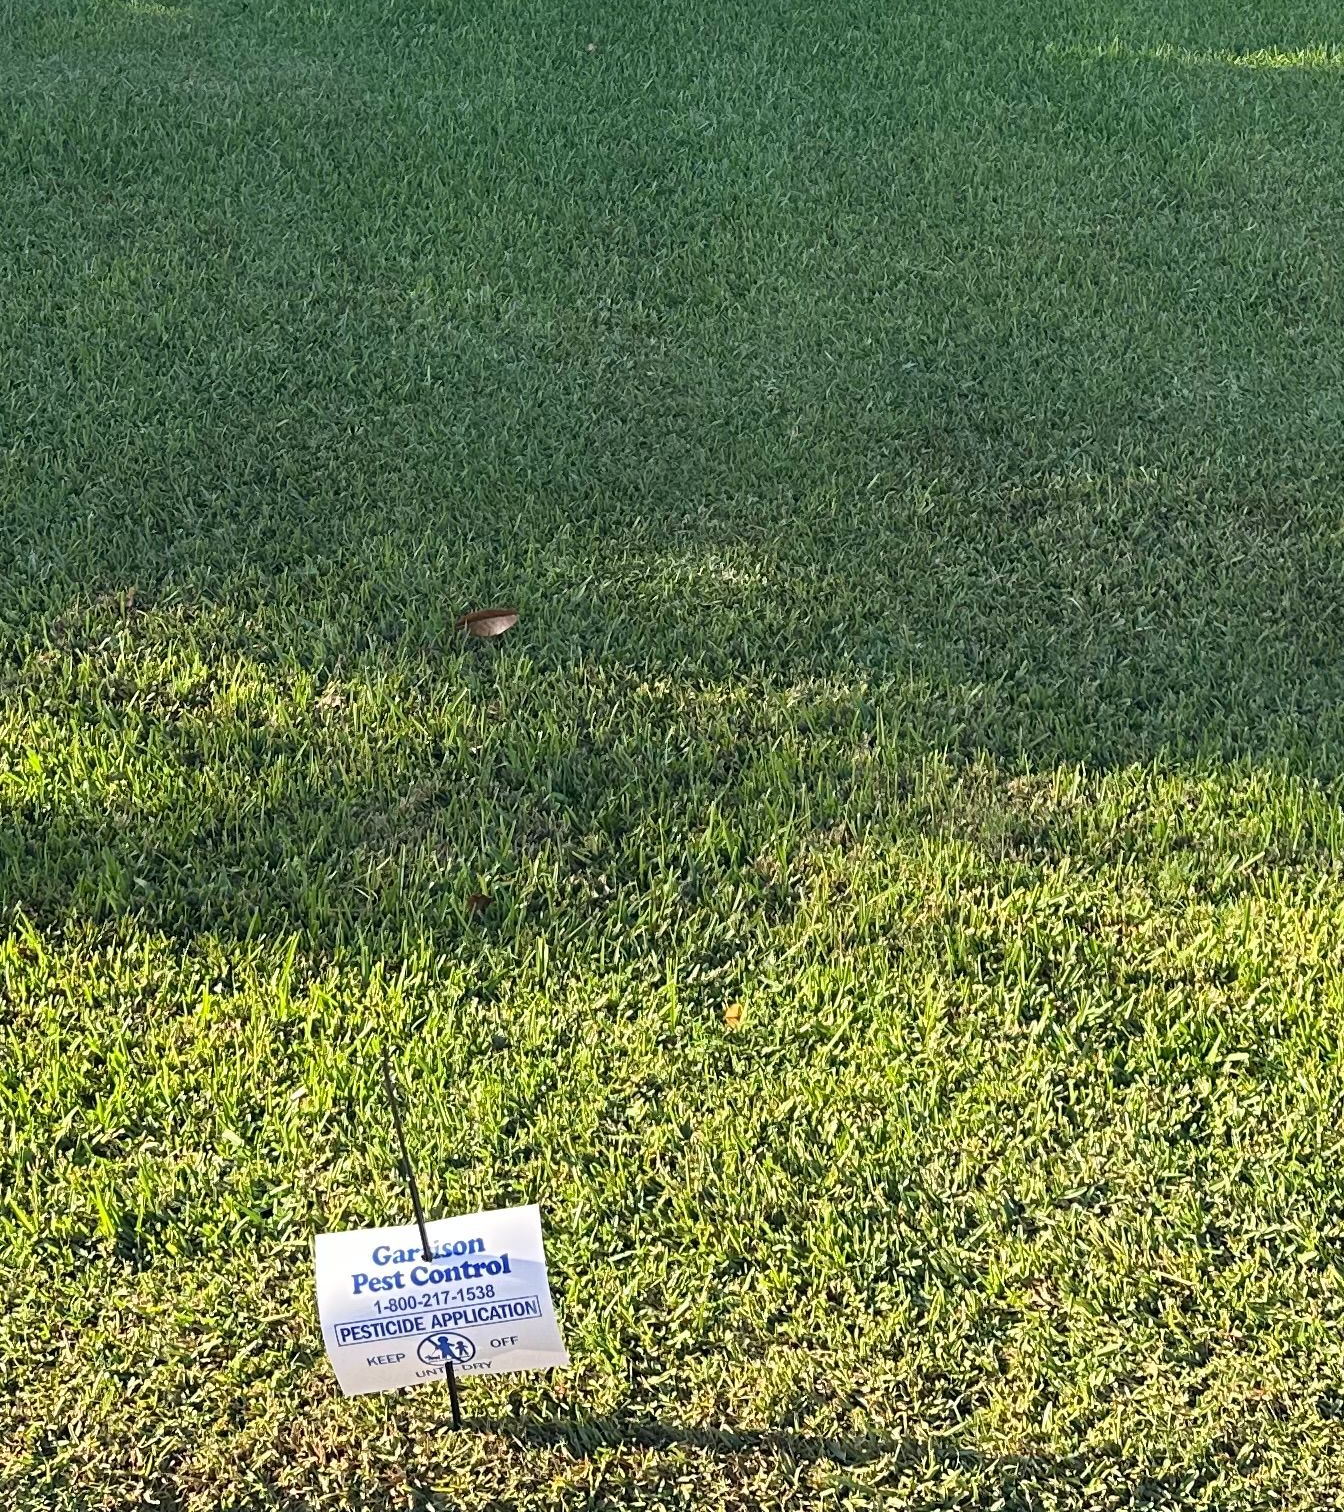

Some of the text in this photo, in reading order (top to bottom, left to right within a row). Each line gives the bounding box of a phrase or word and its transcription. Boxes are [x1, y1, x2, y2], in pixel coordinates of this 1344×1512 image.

[372, 1237, 486, 1266] Garison
[352, 1253, 512, 1294] Pest Control
[373, 1284, 496, 1315] 1-800-217-1538
[340, 1299, 539, 1343] PESTICIDE APPLICATION
[366, 1335, 519, 1367] KEEP OFF
[416, 1361, 492, 1378] UNT DRY
